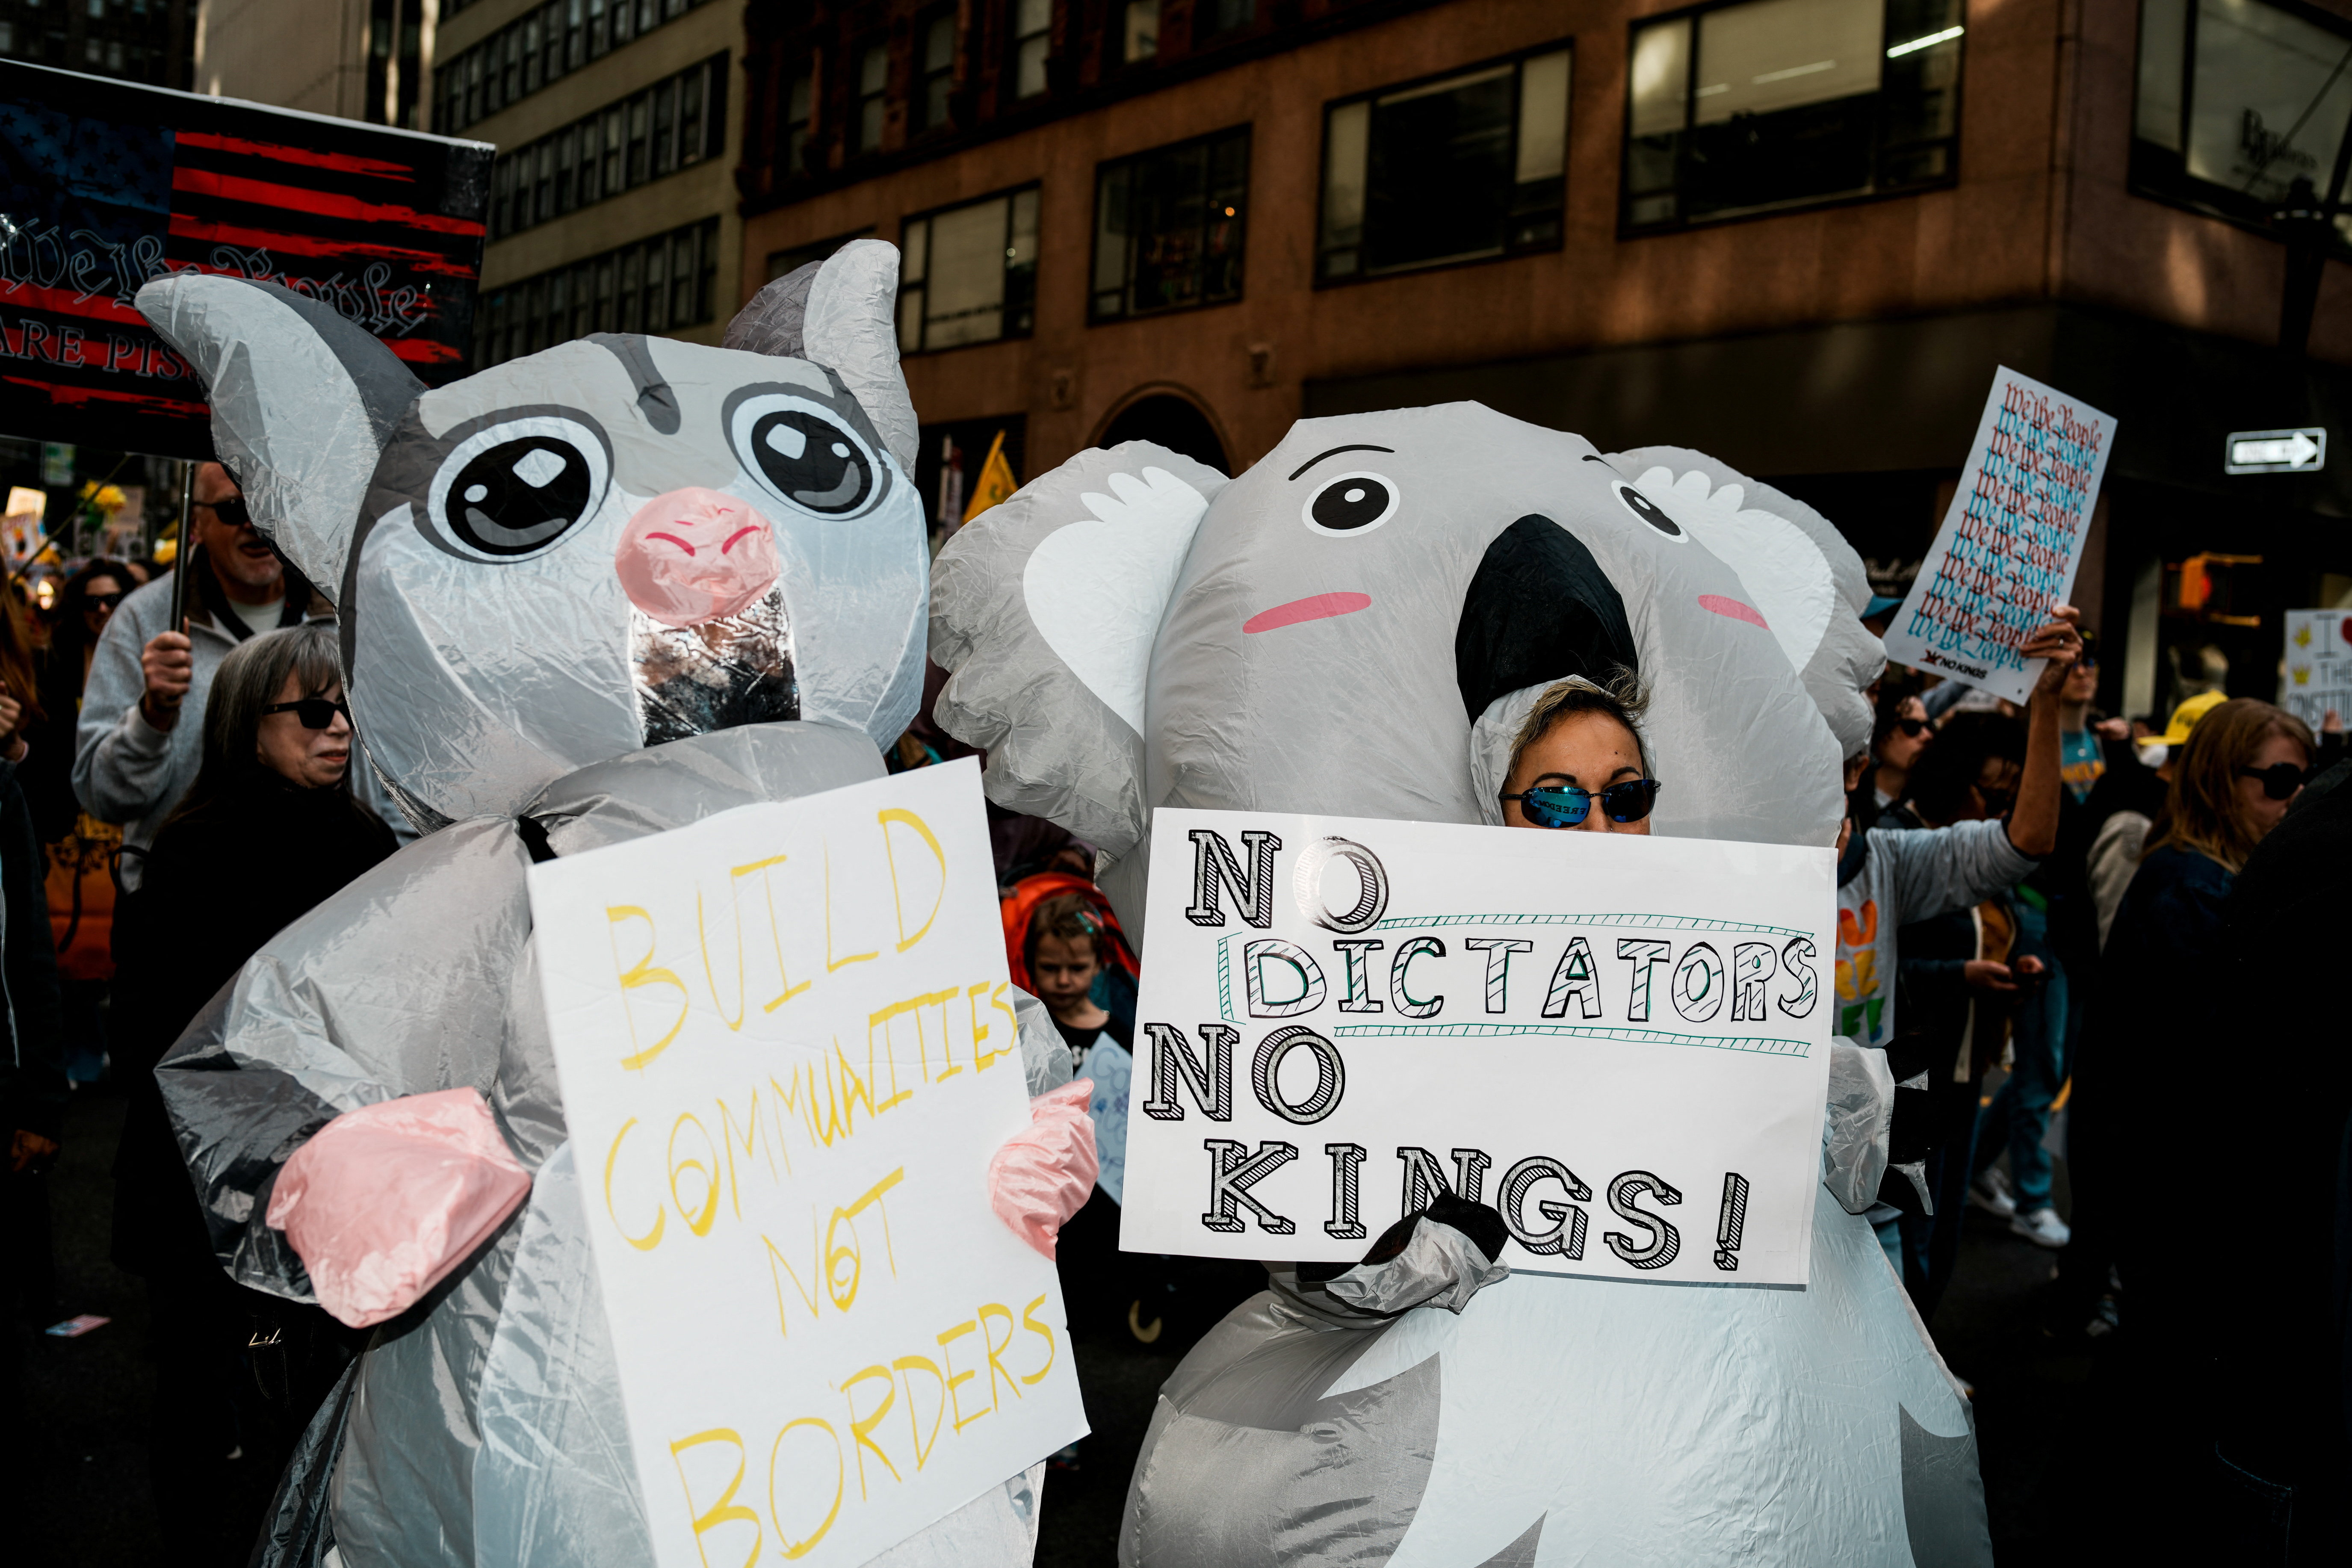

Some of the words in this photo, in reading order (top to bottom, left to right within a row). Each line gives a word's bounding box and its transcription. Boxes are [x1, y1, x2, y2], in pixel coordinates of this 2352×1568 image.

[2004, 381, 2030, 420] We
[1997, 404, 2024, 441] We
[1991, 424, 2018, 462] We
[1984, 447, 2012, 484] We
[1976, 467, 2004, 505] We
[1968, 489, 1997, 526] We
[1959, 509, 1989, 546] We
[1950, 531, 1980, 567] We
[1930, 570, 1962, 606] We
[1941, 551, 1972, 587] We
[1908, 609, 1940, 642] We
[1920, 590, 1950, 624] We
[1939, 658, 1957, 670] NO
[1956, 663, 1988, 679] KINGS
[1185, 829, 1389, 935] NO
[606, 807, 946, 1075] BUILD
[1244, 936, 1818, 1023] DICTATORS
[1143, 1022, 1346, 1125] NO
[604, 980, 1018, 1251] COMMUNITIES
[1202, 1138, 1749, 1271] KINGS!
[762, 1166, 904, 1339] NOT
[669, 1293, 1055, 1568] BORDERS
